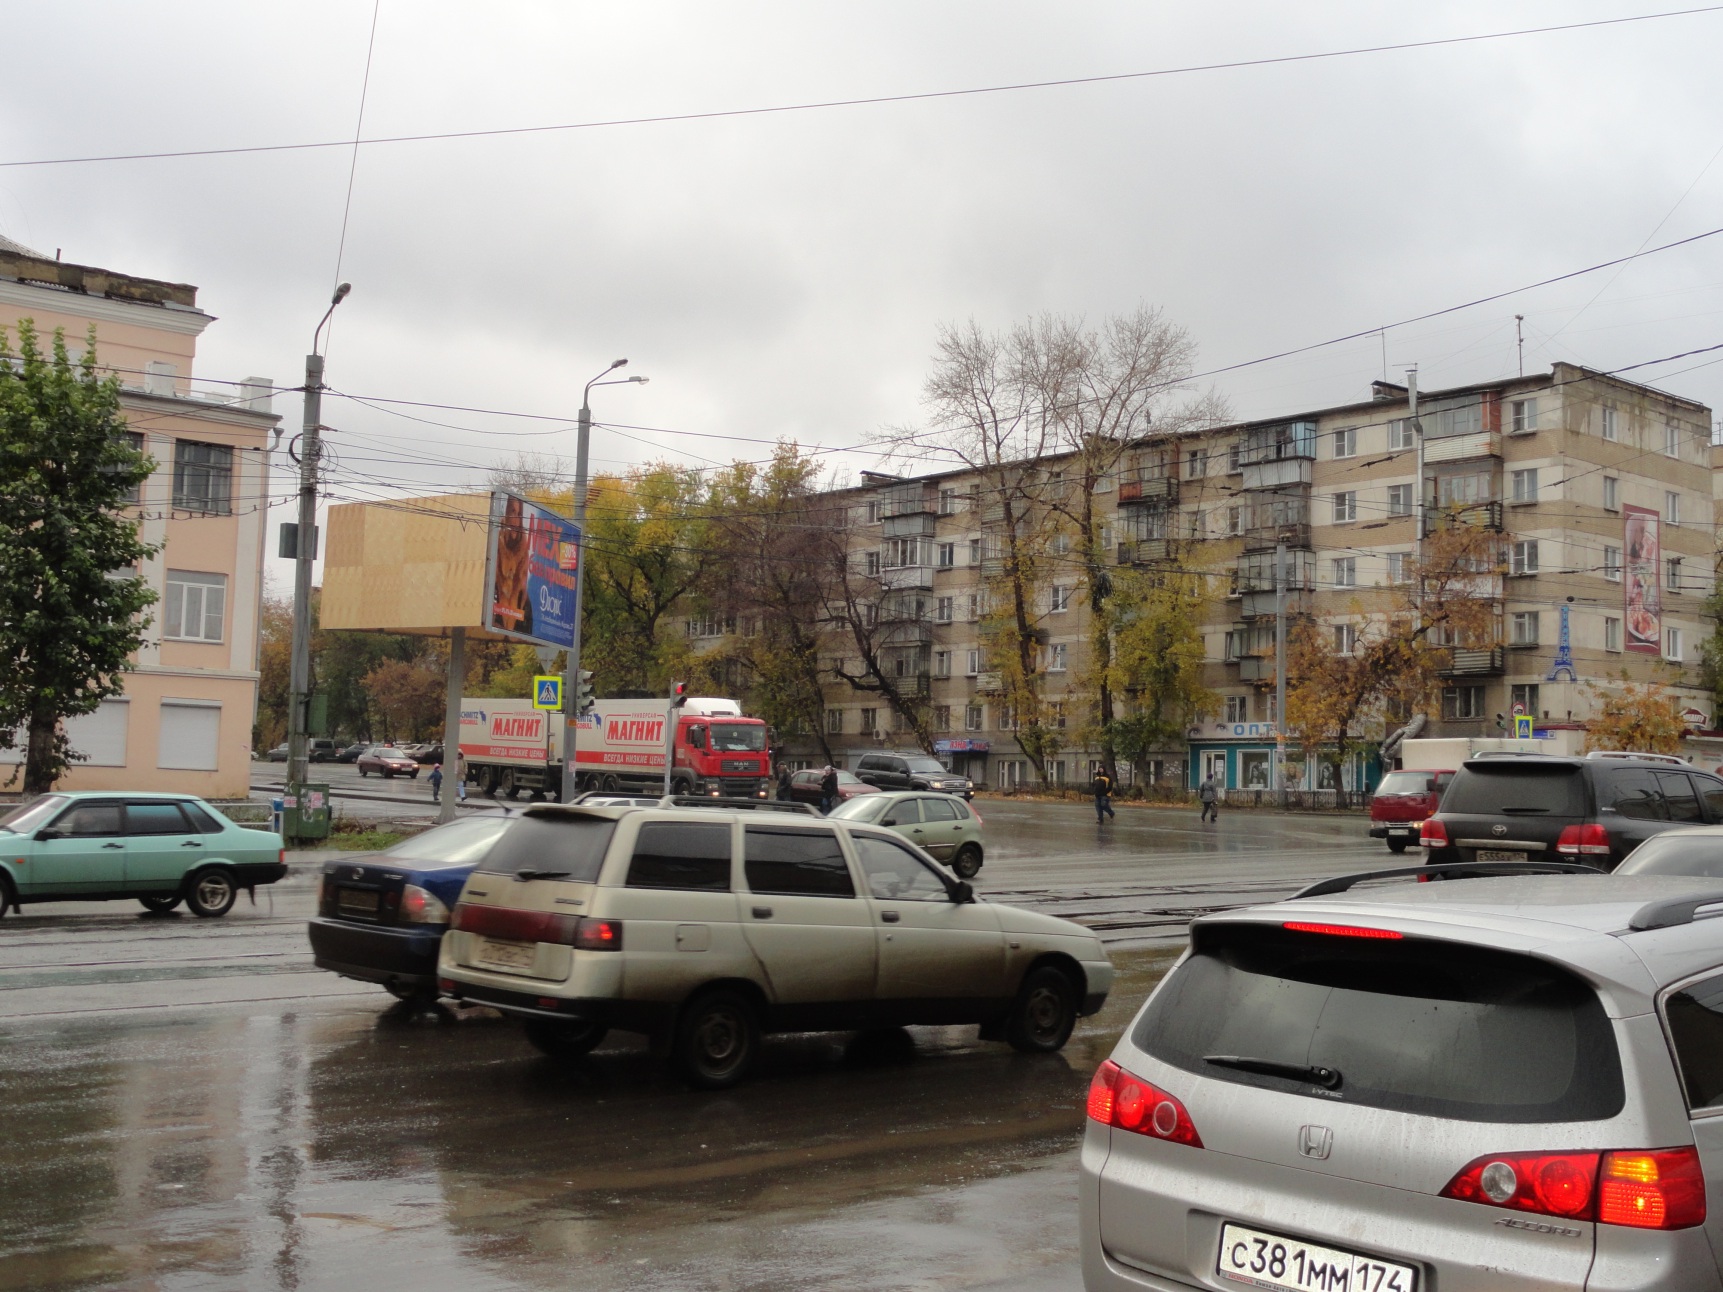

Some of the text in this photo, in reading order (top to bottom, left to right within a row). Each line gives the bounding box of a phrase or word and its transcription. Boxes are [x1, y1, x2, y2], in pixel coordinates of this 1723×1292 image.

[528, 513, 563, 563] МЕХ
[545, 566, 576, 591] правил
[492, 718, 541, 737] МАГНИТ
[607, 720, 663, 741] МАГНИТ
[489, 747, 545, 758] ВСЕГДА НИЗКИЕ ЦЕНЫ
[603, 753, 624, 763] ВСЕГДА
[625, 754, 647, 764] НИЗКИЕ
[1493, 1217, 1582, 1238] ACCORD
